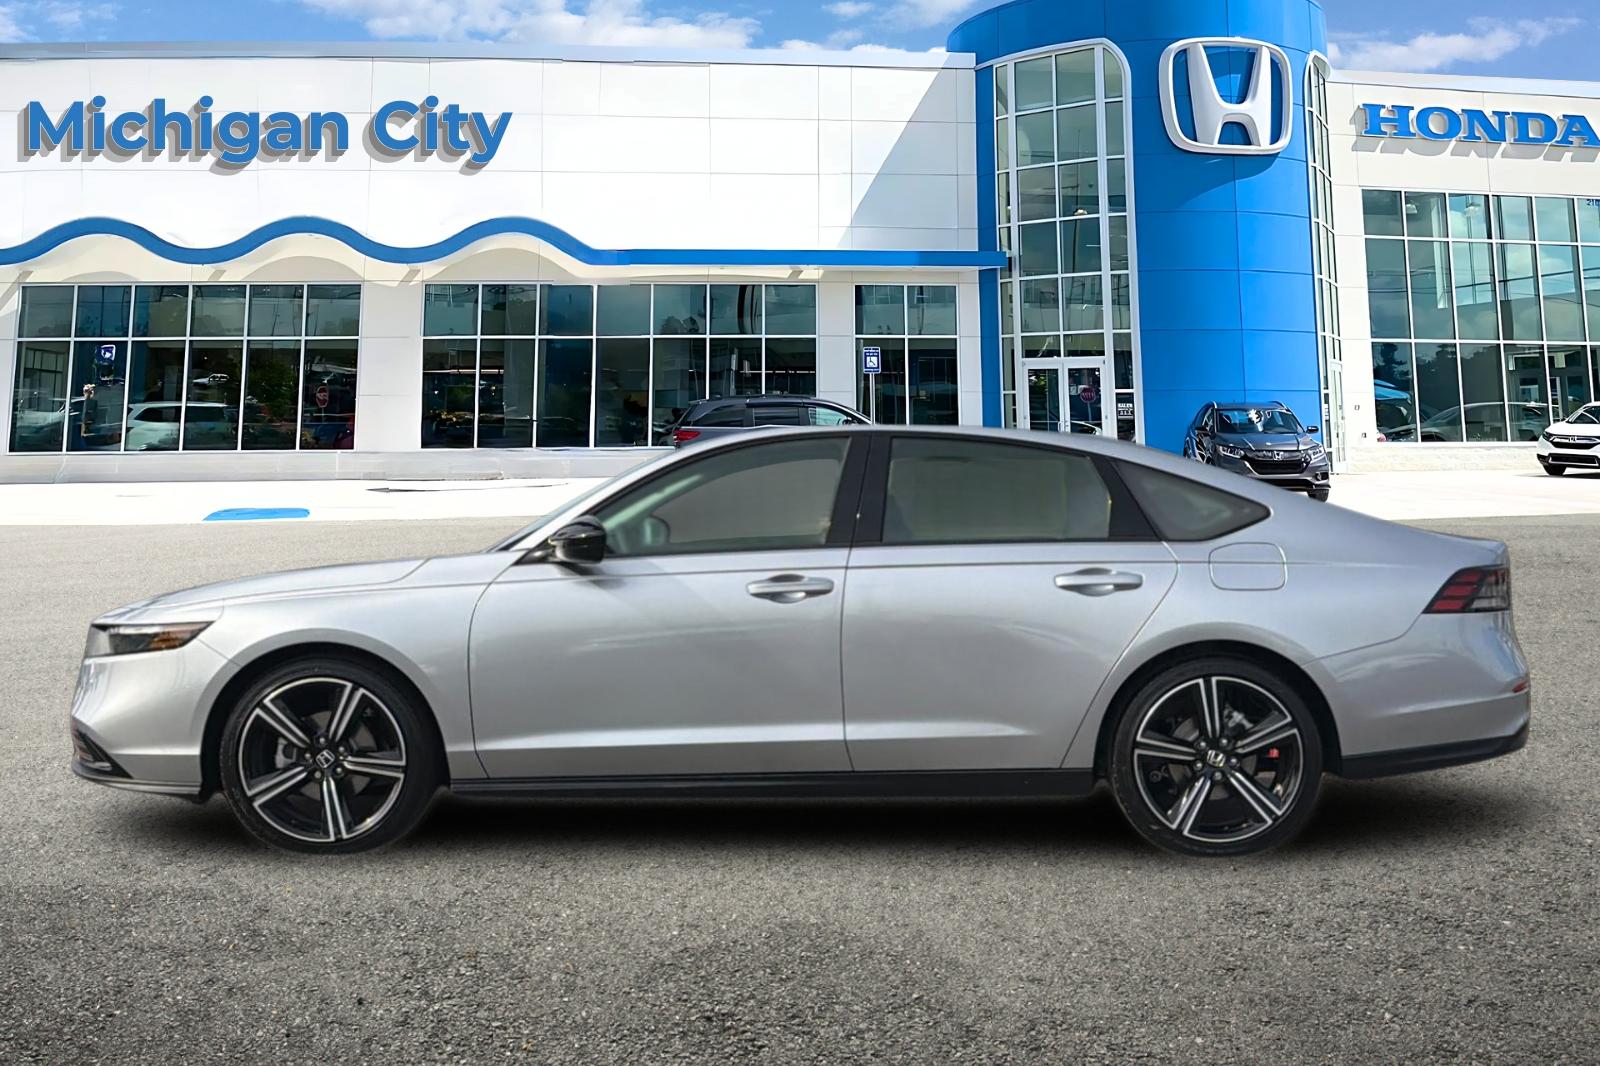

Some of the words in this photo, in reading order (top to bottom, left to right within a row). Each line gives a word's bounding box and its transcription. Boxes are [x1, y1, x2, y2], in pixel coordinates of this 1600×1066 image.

[29, 95, 349, 164] Michigan
[374, 95, 513, 164] City
[1362, 103, 1600, 147] HONDA
